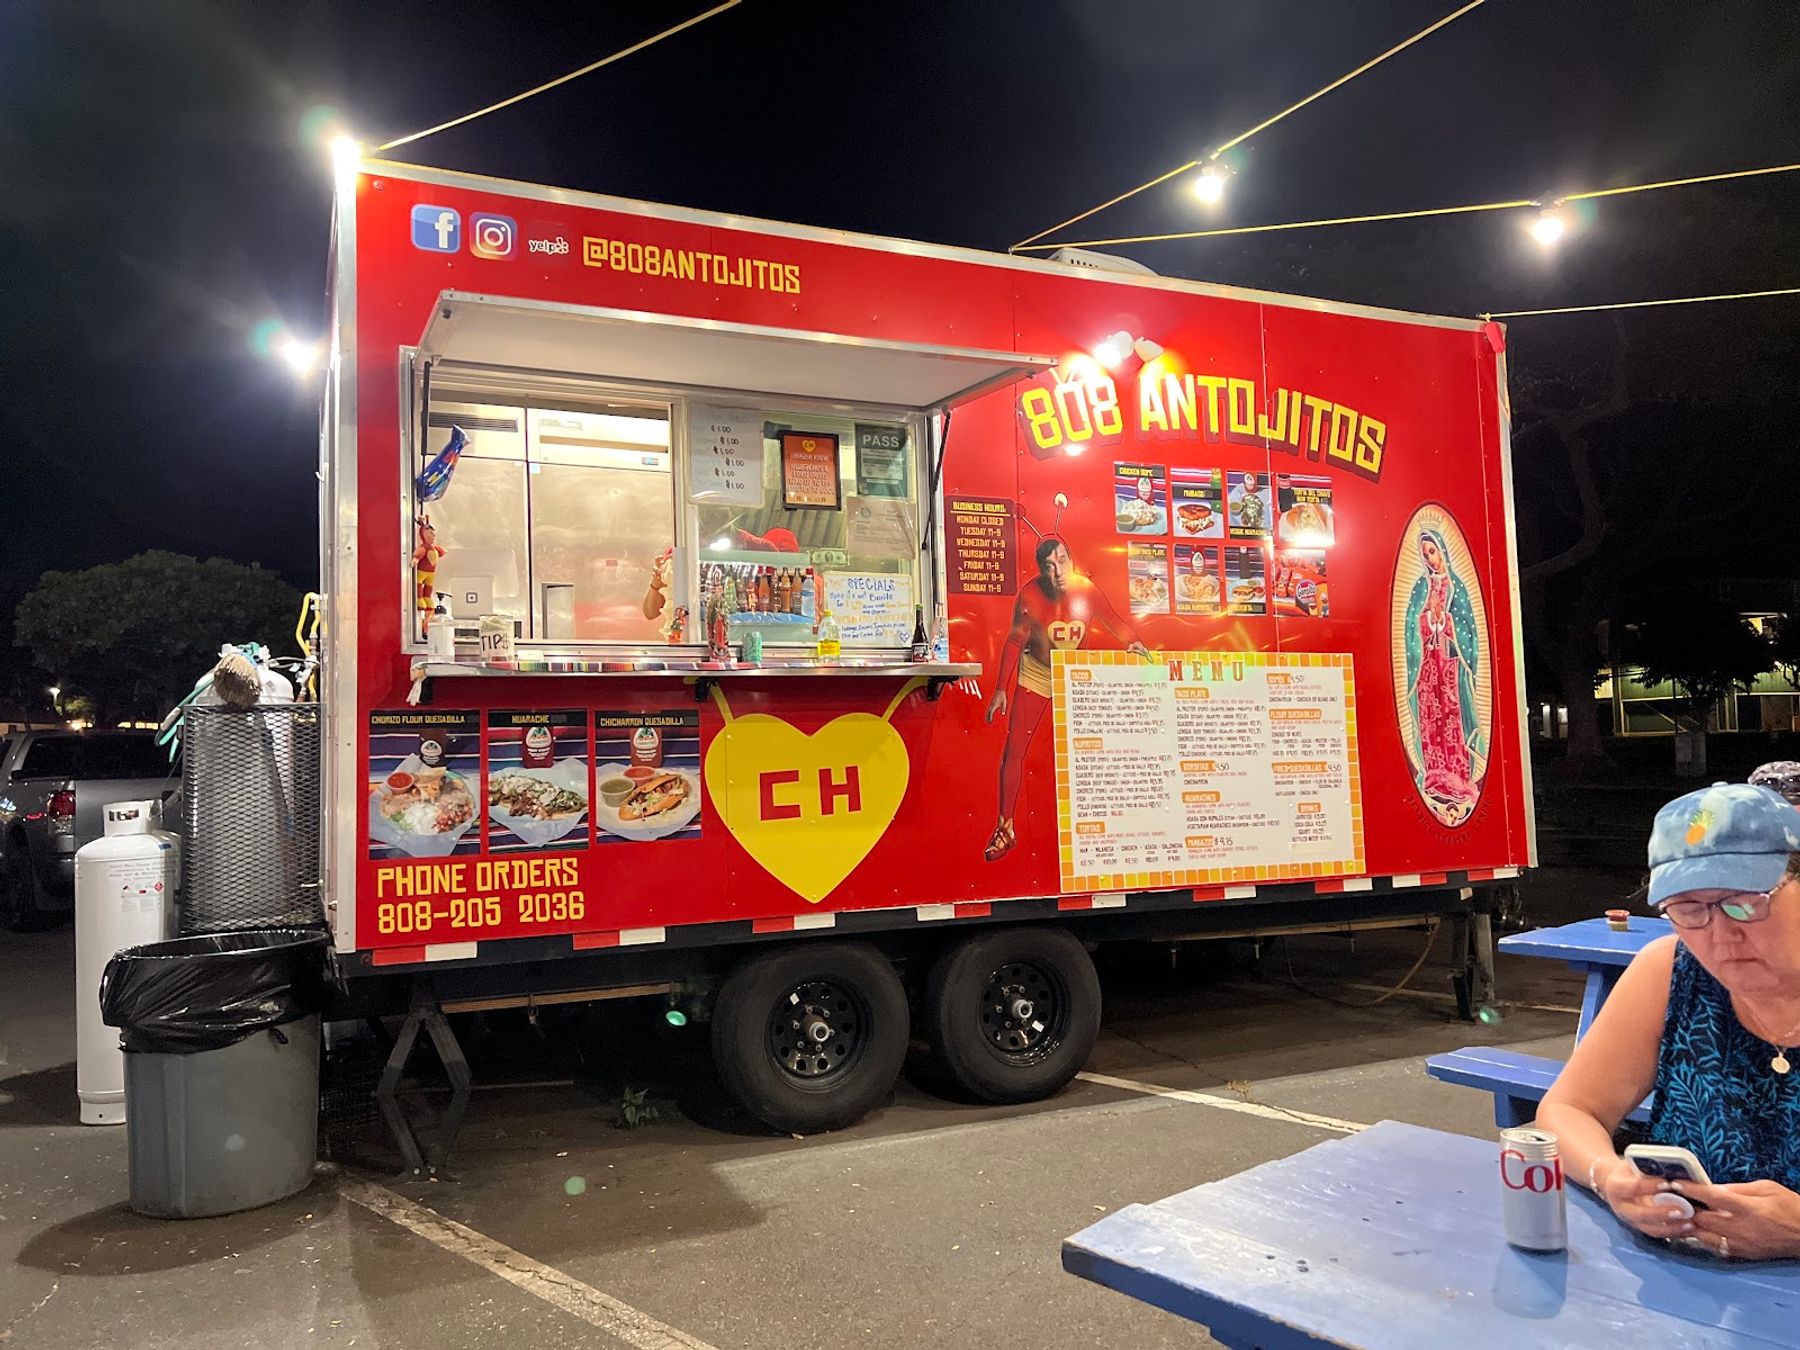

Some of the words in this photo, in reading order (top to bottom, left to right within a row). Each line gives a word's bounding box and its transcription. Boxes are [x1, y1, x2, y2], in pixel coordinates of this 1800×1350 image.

[529, 239, 556, 255] yelp
[583, 236, 800, 294] @808ANTOJITOS
[1022, 377, 1123, 449] 808
[1140, 374, 1386, 473] ANTOJITOS
[863, 434, 899, 448] PASS
[953, 502, 983, 511] BUSINESS
[957, 515, 980, 524] MONDAY
[981, 517, 1004, 526] CLOSED
[960, 527, 987, 535] TUESDAY
[988, 528, 1001, 537] 11-9
[957, 538, 990, 546] WEDNESDAY
[992, 540, 1005, 548] 11-9
[958, 549, 990, 558] THURSDAY
[991, 551, 1004, 559] 11-9
[964, 561, 985, 569] FRIDAY
[960, 571, 989, 580] SATURDAY
[991, 573, 1004, 581] 11-9
[848, 578, 895, 591] SPECIALS
[963, 583, 986, 591] SUNDAY
[1053, 627, 1081, 641] CH
[1169, 661, 1243, 681] MENU
[372, 715, 401, 724] CHORIZO
[402, 715, 423, 724] FLOUR
[425, 715, 465, 724] QUESADILLA
[512, 715, 550, 724] HUARACHE
[600, 717, 644, 726] CHICHARRON
[645, 717, 684, 726] QUESADILLA
[759, 765, 862, 821] CH
[378, 864, 466, 898] PHONE
[476, 857, 578, 891] ORDERS
[378, 897, 501, 934] 808-205
[519, 891, 584, 923] 2036
